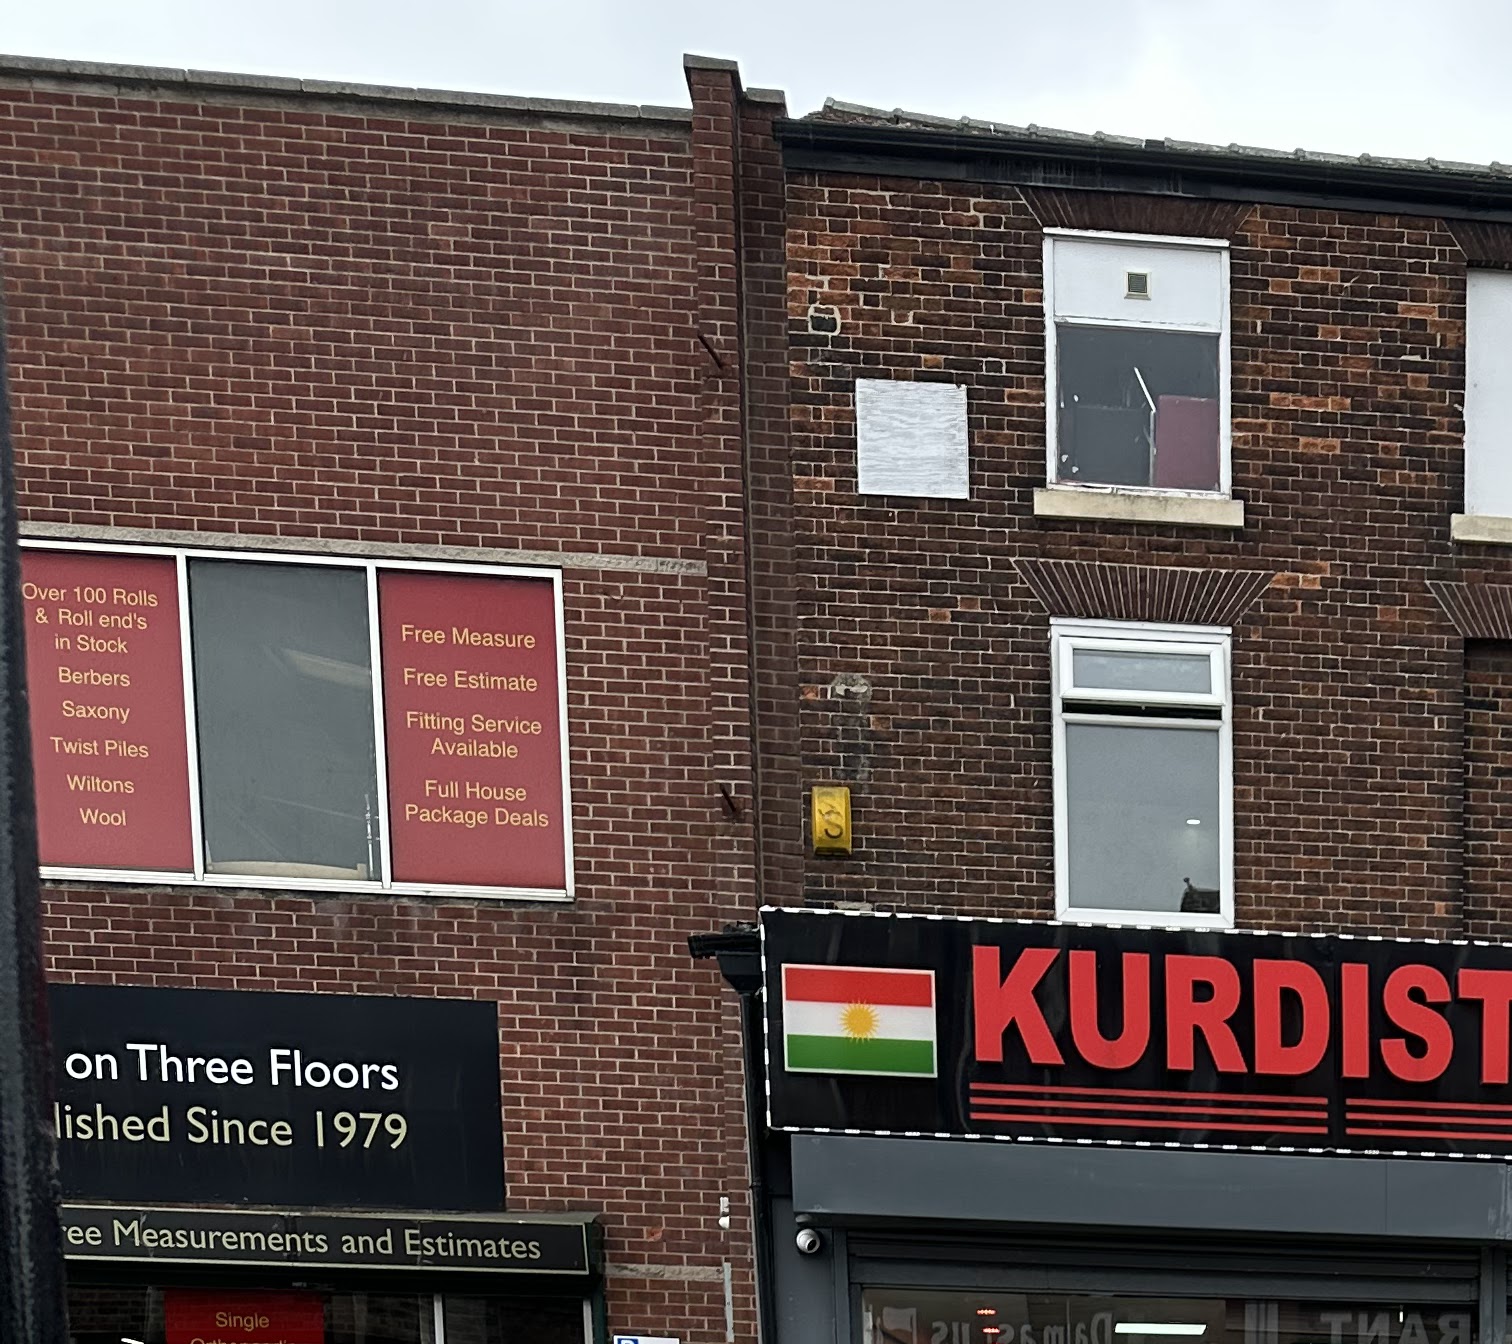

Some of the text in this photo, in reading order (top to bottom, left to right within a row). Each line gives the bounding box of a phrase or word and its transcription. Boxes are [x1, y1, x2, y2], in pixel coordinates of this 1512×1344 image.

[22, 583, 158, 607] Over 100 Rolls
[35, 608, 148, 630] & Roll end's
[55, 634, 128, 653] in Stock
[401, 625, 536, 648] Free Measure
[58, 667, 131, 686] Berbers
[404, 668, 538, 692] Free Estimate
[62, 701, 130, 724] Saxony
[406, 711, 542, 735] Fitting Service
[50, 737, 149, 758] Twist Piles
[431, 738, 518, 758] Available
[67, 774, 135, 793] Wiltons
[425, 780, 527, 801] Full House
[80, 808, 127, 826] Wool
[405, 804, 549, 829] Package Deals
[65, 1043, 399, 1090] on Three Floors
[186, 1106, 293, 1146] Since
[316, 1111, 408, 1150] 1979
[112, 1219, 328, 1253] Measurements
[341, 1228, 393, 1255] and
[404, 1228, 541, 1259] Estimates
[215, 1311, 270, 1332] Single
